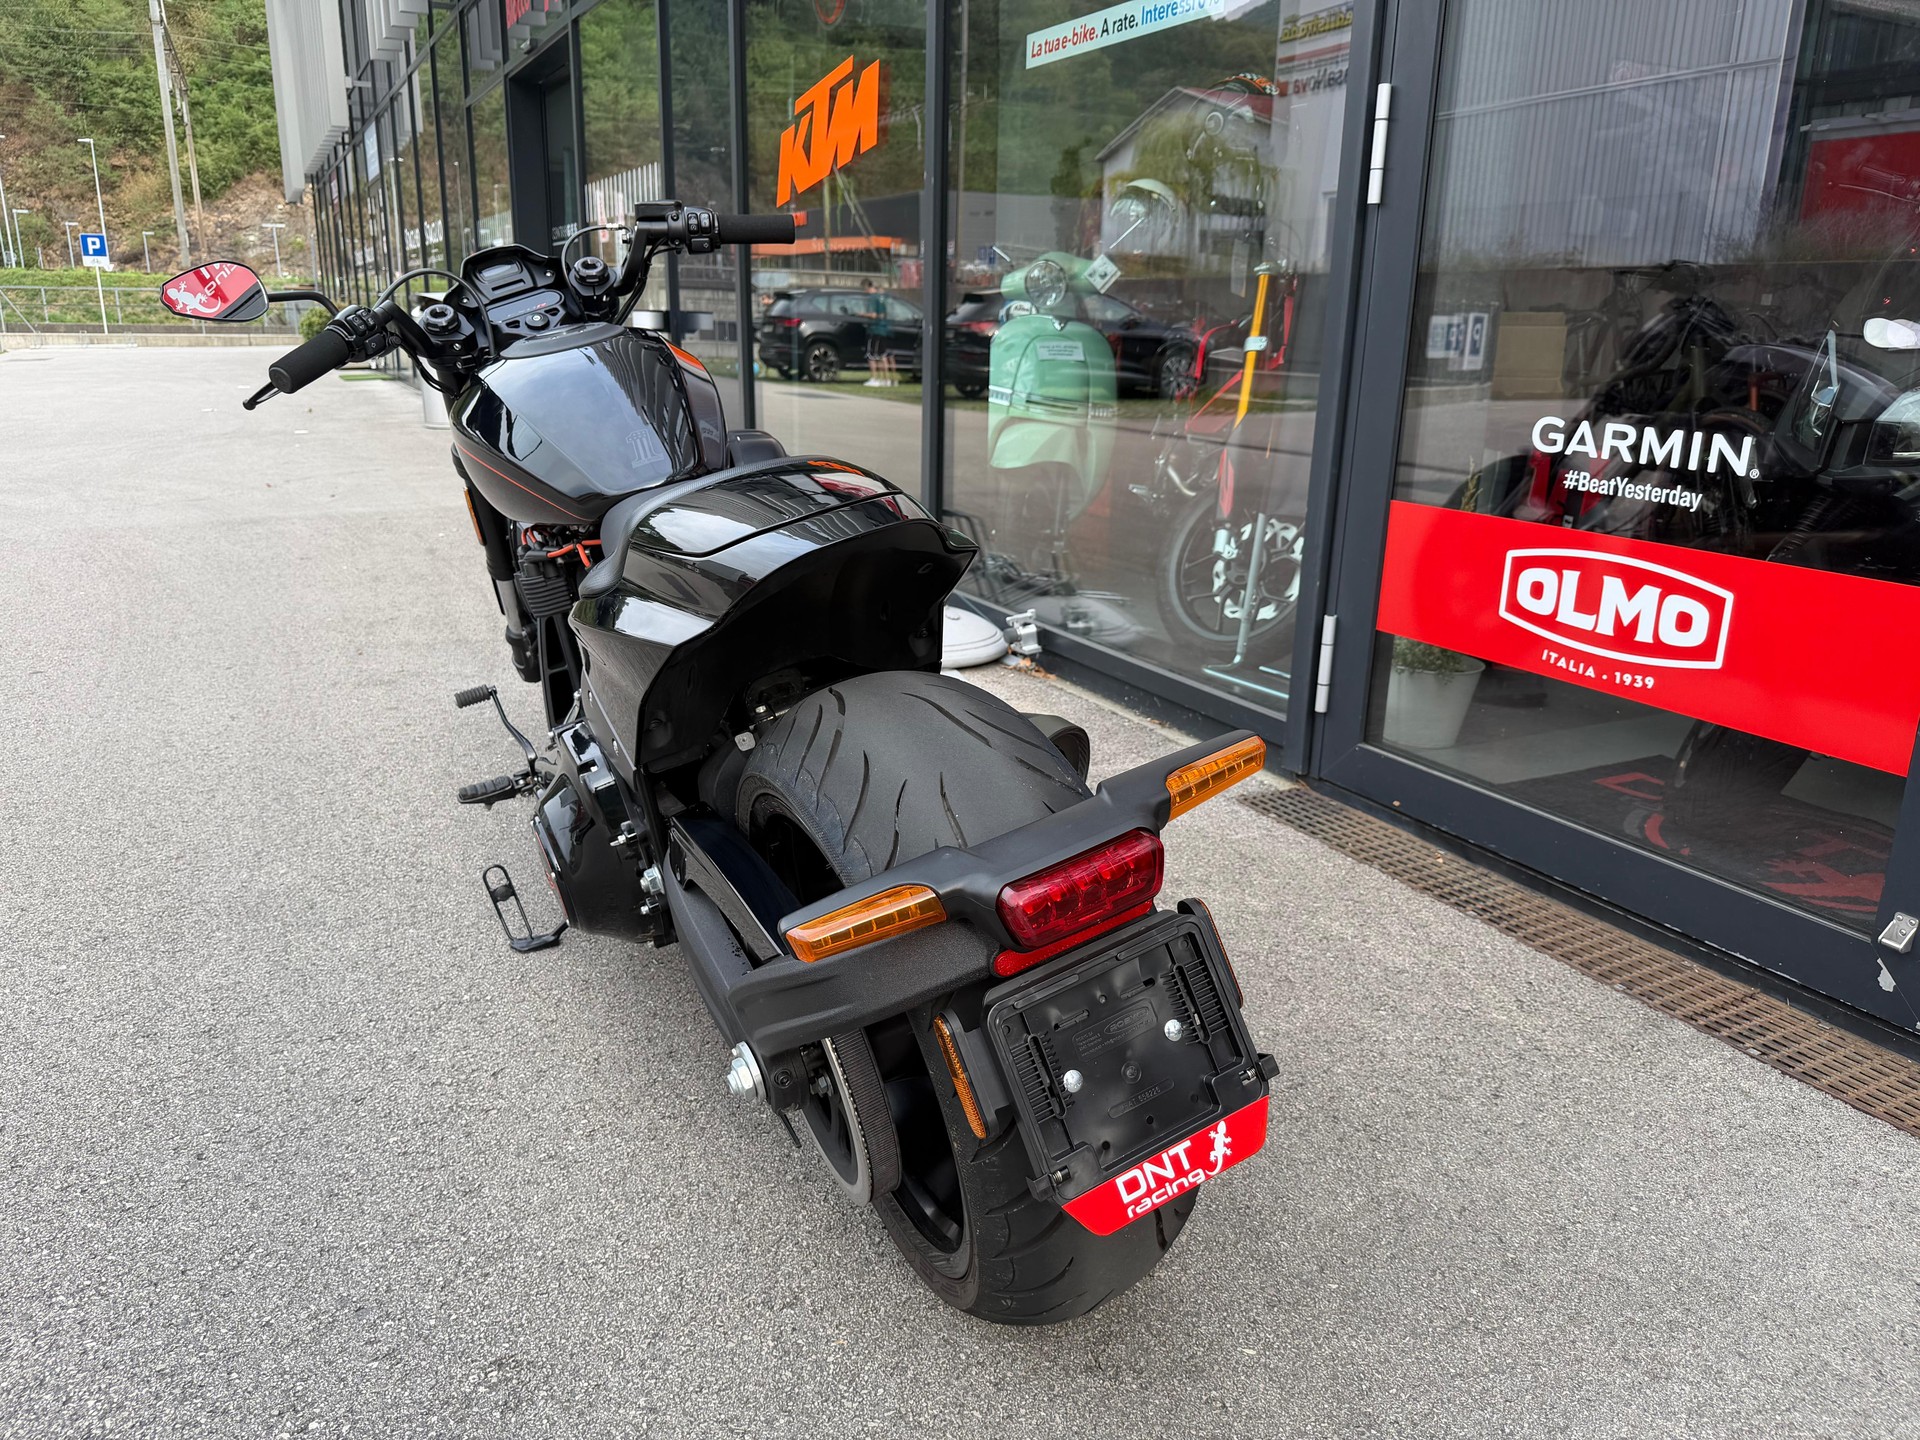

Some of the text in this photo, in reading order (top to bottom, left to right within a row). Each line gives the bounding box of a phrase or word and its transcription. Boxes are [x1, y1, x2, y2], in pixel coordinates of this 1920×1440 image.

[1101, 18, 1109, 37] A
[1112, 13, 1138, 34] rate.
[777, 54, 880, 208] KTM
[87, 237, 101, 255] P
[1563, 469, 1703, 513] #BeatYesterday
[1516, 567, 1710, 647] OLMO
[1541, 649, 1655, 689] ITALIA 1939
[1115, 1140, 1191, 1204] DNT
[1126, 1168, 1206, 1218] racing
